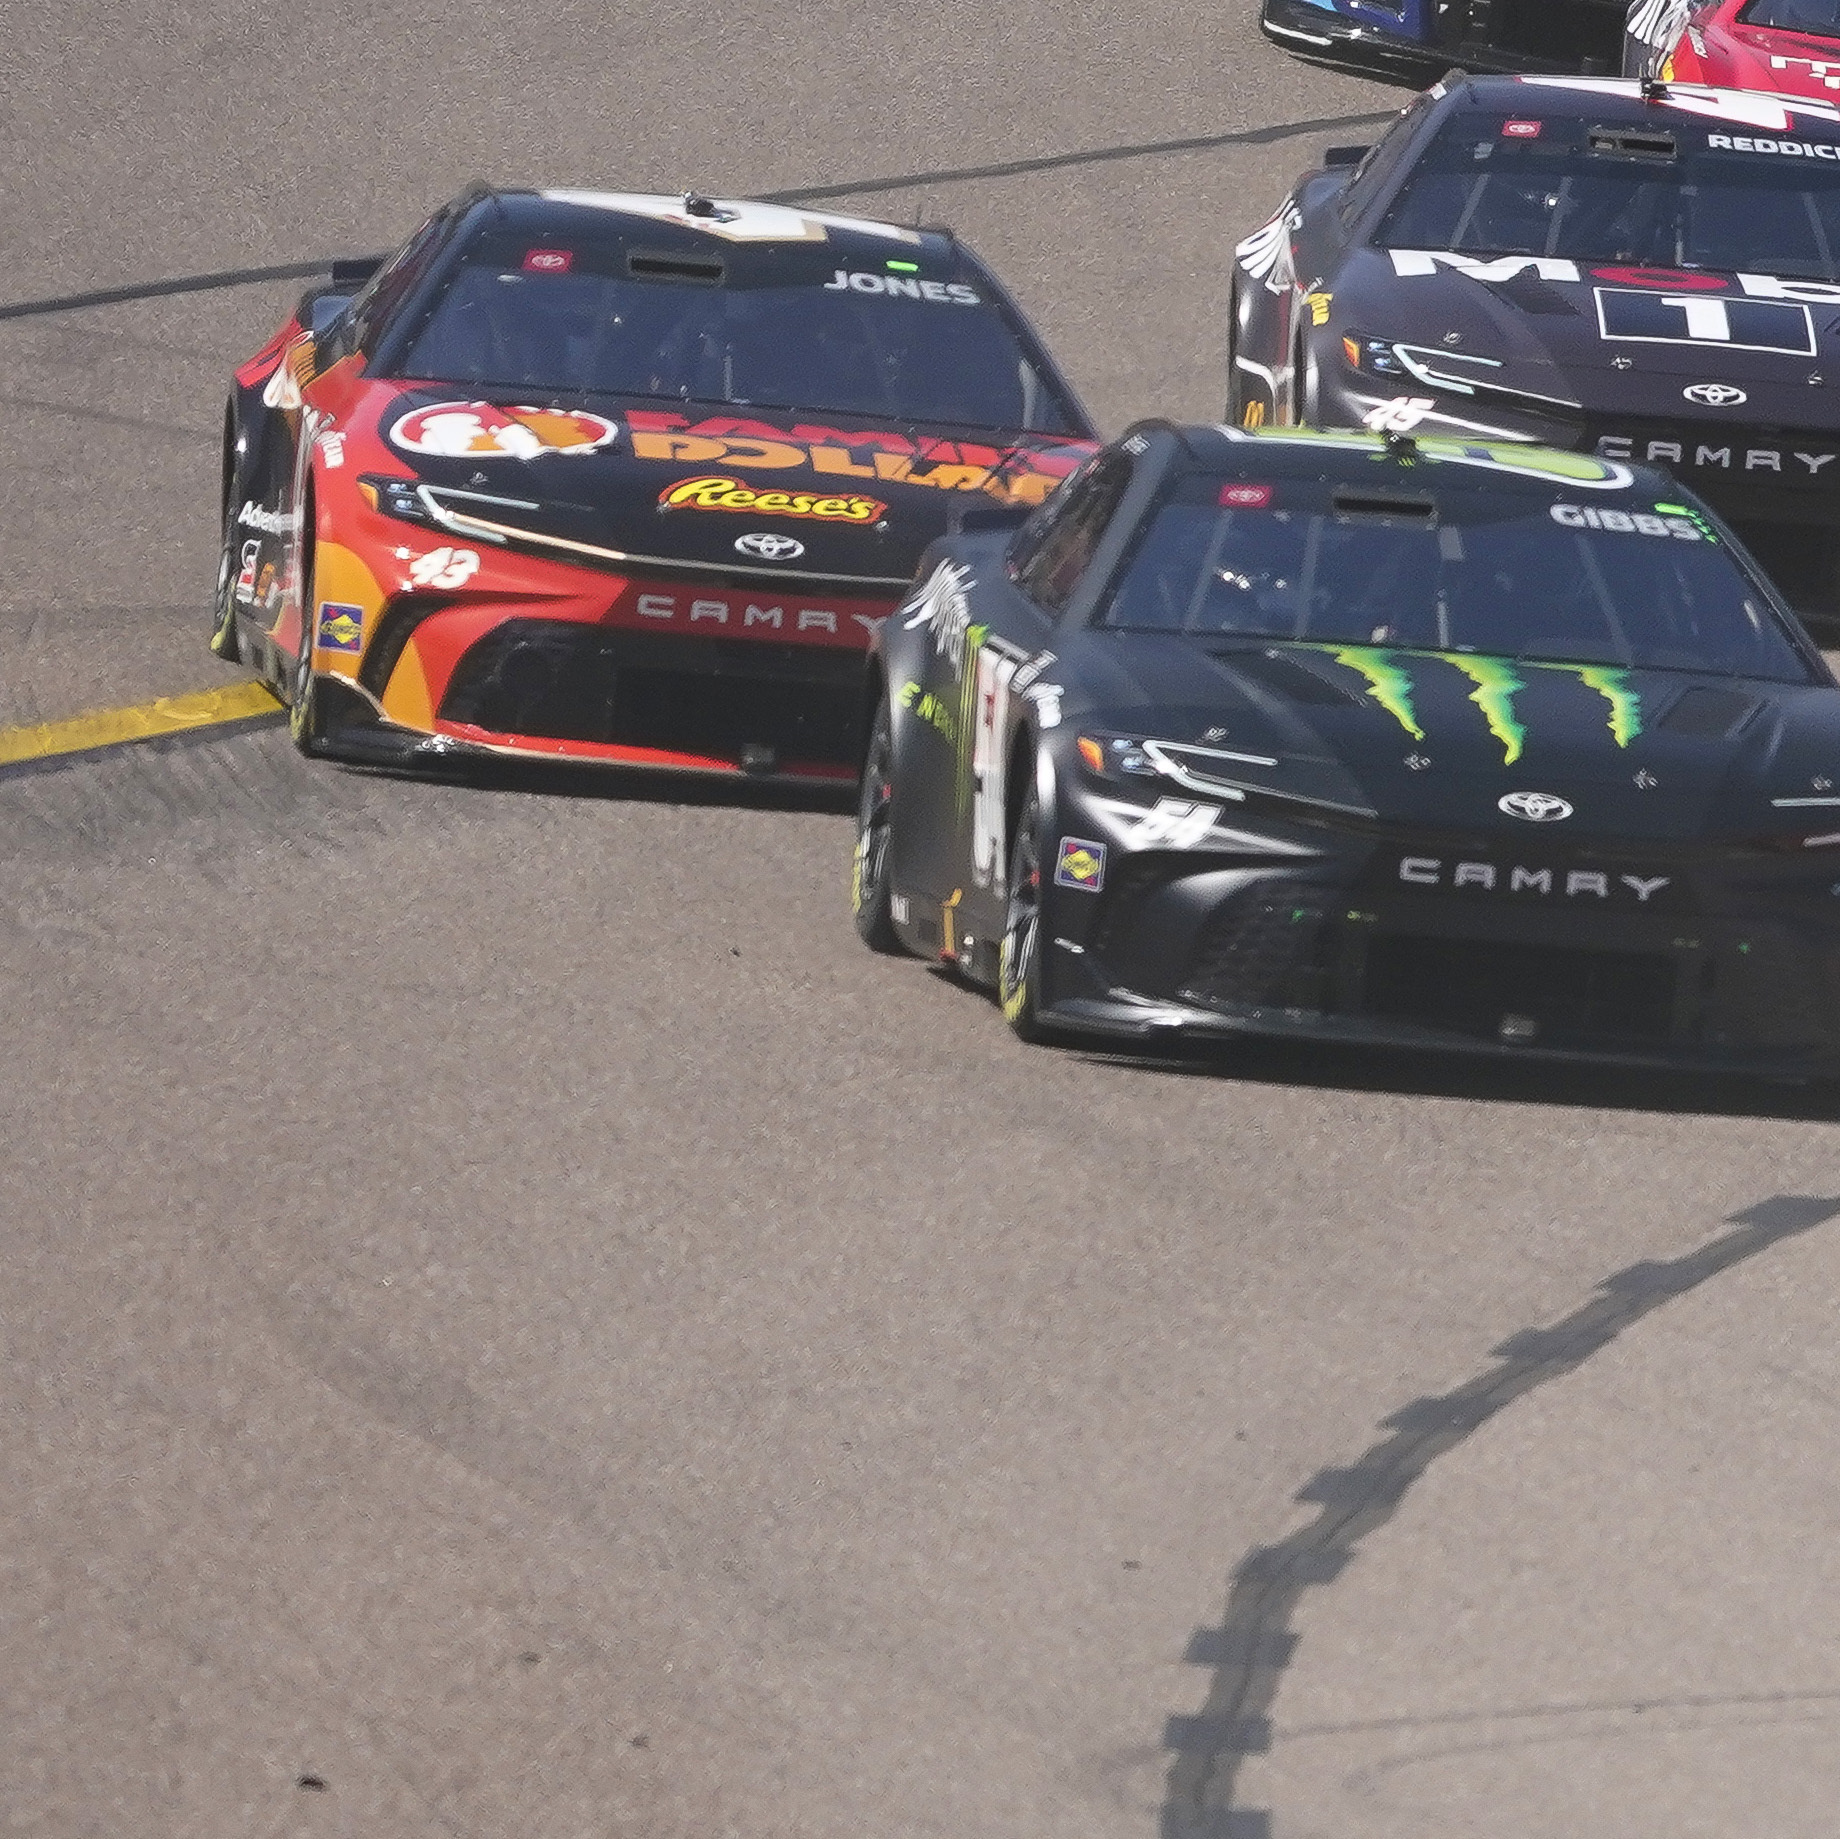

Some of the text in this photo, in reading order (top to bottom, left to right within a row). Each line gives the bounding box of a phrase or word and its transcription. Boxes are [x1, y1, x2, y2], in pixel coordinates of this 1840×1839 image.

[823, 269, 982, 307] JONES
[1661, 297, 1732, 341] 1
[1597, 437, 1836, 475] CAMRY
[666, 479, 875, 519] Reese's
[1550, 502, 1702, 541] GIBBS
[637, 593, 887, 636] CAMRY
[1401, 856, 1671, 902] CAMRY
